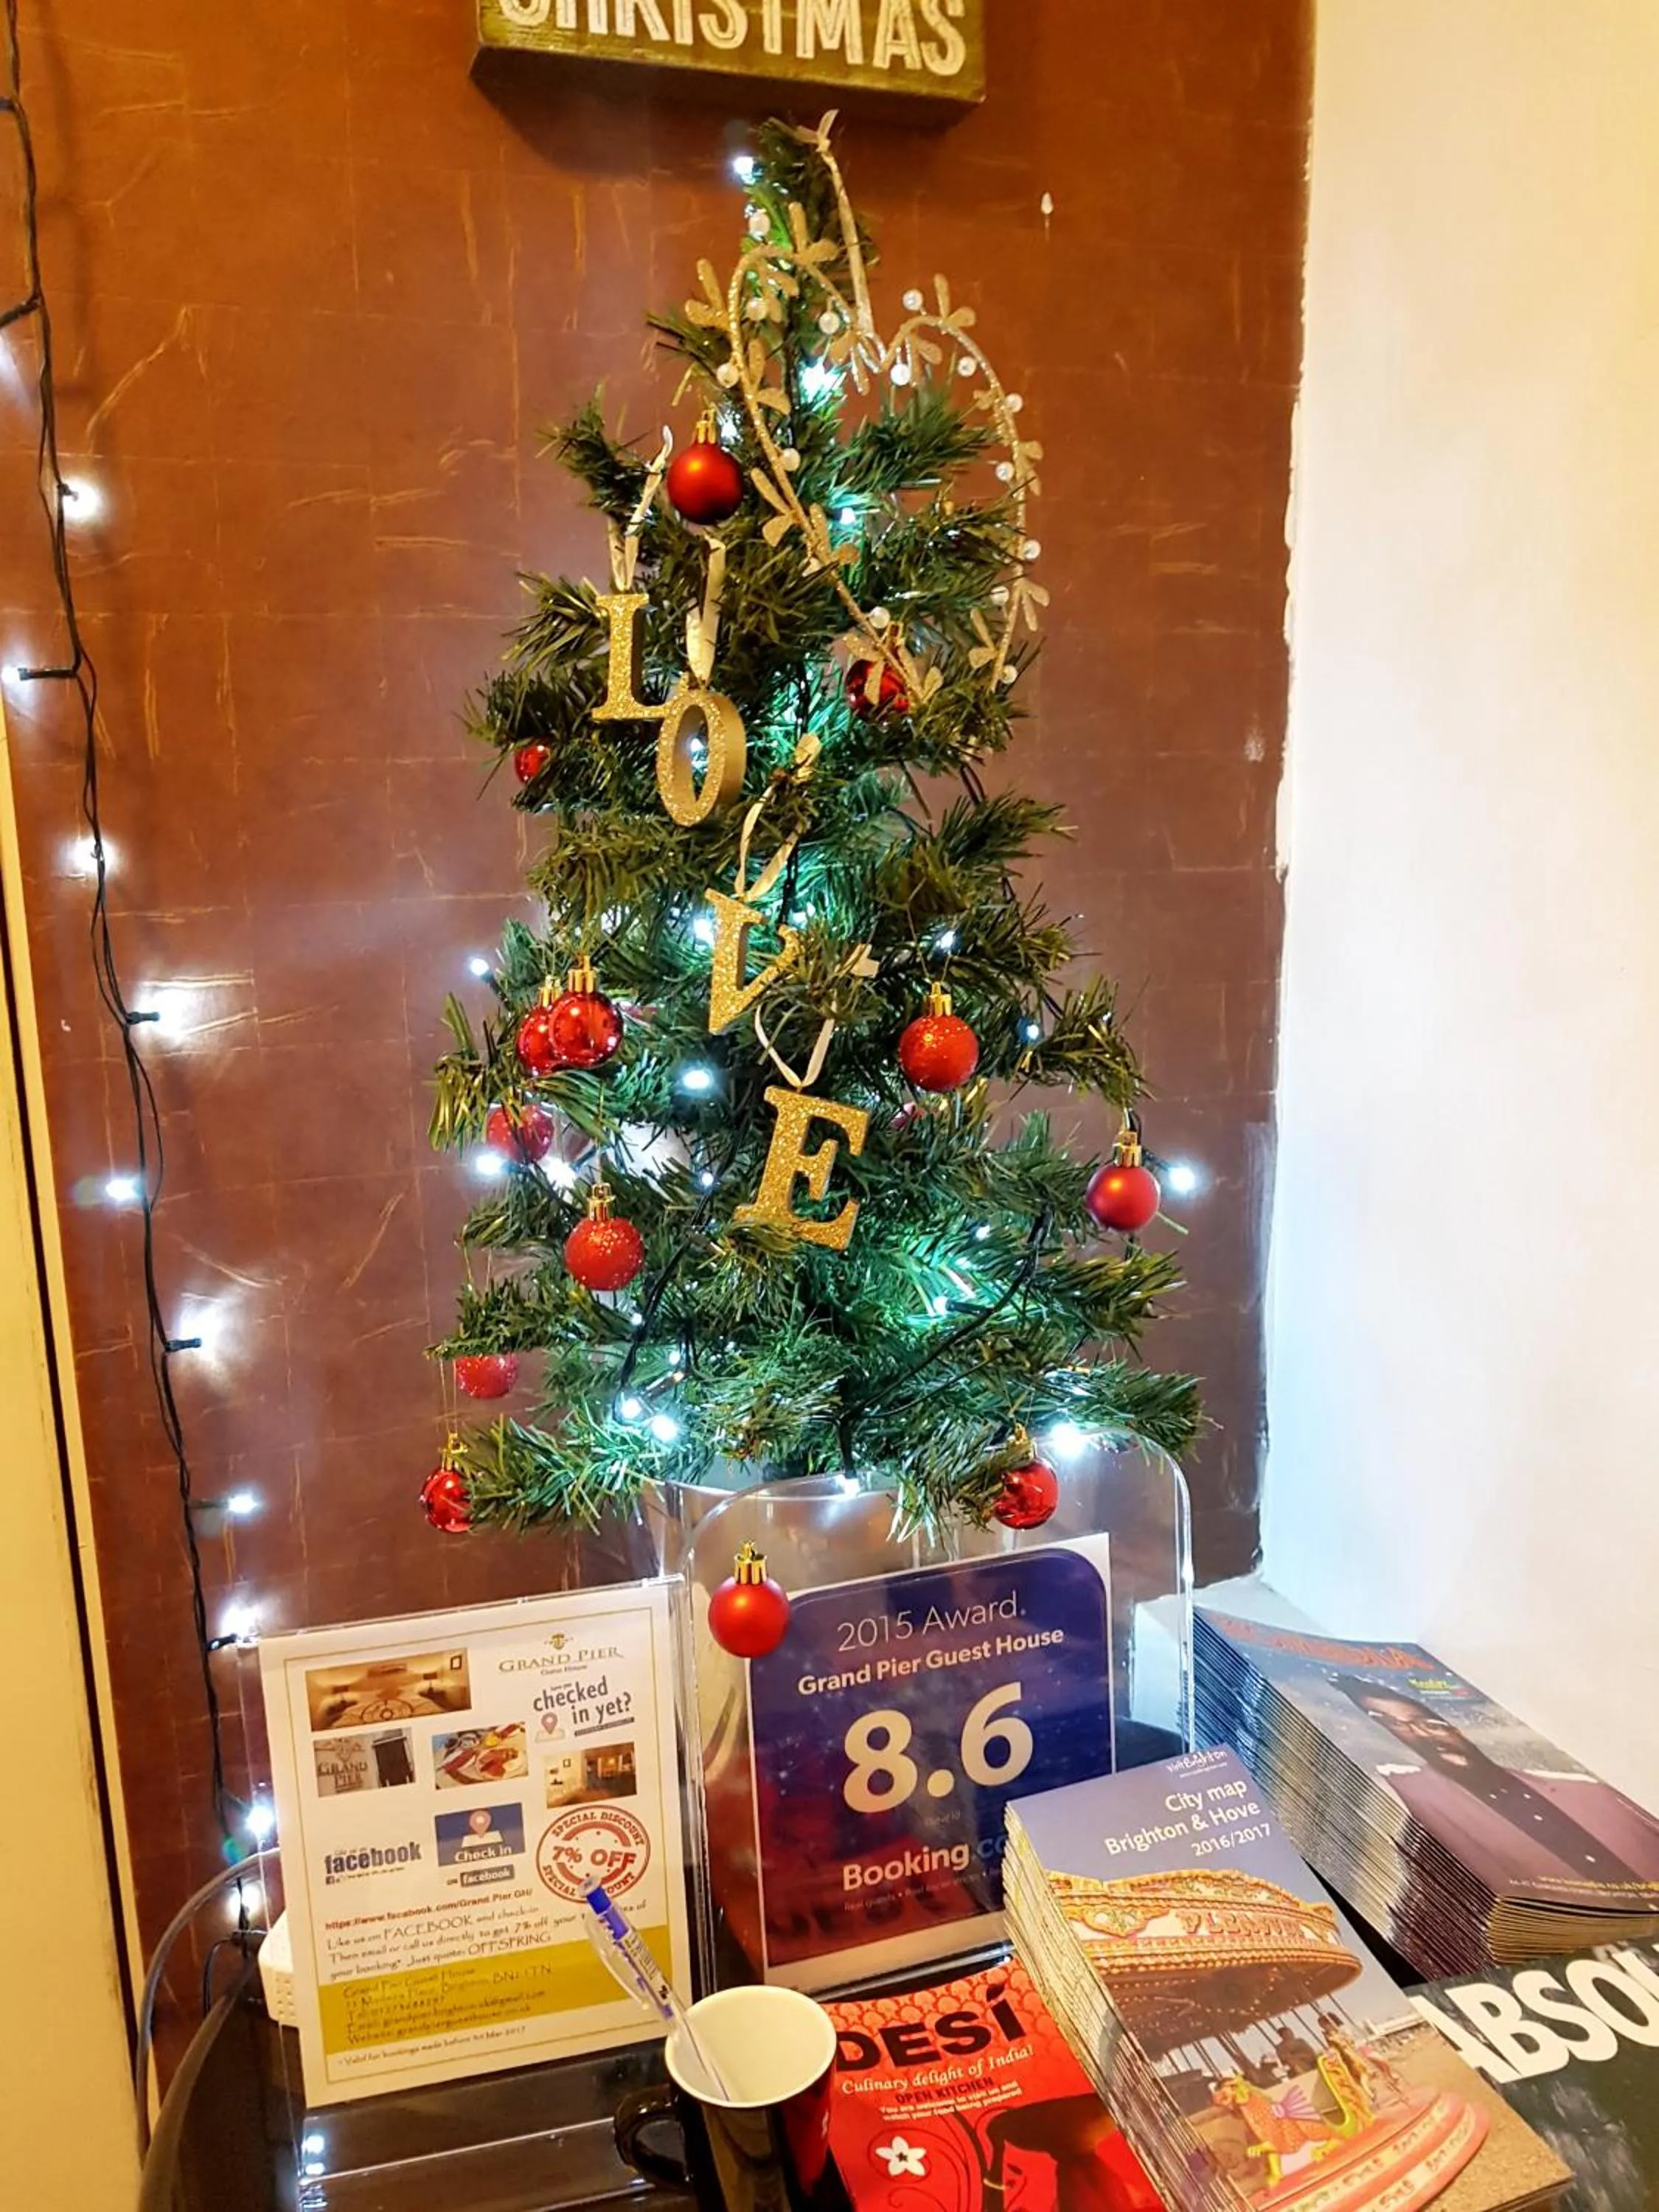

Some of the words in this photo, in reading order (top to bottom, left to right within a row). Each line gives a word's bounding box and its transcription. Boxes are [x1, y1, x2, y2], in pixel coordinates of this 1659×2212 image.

[500, 0, 966, 75] ISTMAS
[838, 1611, 914, 1652] 2015
[922, 1590, 1026, 1636] Award.
[498, 1655, 571, 1673] GRAND
[578, 1646, 624, 1660] PIER
[798, 1667, 872, 1696] Grand
[877, 1658, 922, 1680] Pier
[925, 1644, 992, 1671] Guest
[996, 1628, 1065, 1655] House
[532, 1674, 608, 1711] checked
[571, 1703, 590, 1725] in
[595, 1691, 632, 1725] yet?
[843, 1682, 1034, 1813] 8.6
[1166, 1792, 1203, 1811] City
[1207, 1781, 1248, 1801] map
[552, 1812, 597, 1837] SPECIAL
[600, 1812, 644, 1846] DISCOUNT
[1105, 1822, 1190, 1855] Brighton
[1192, 1815, 1209, 1832] &
[1210, 1802, 1262, 1826] Hove
[1191, 1823, 1271, 1857] 2016/2017
[324, 1841, 422, 1874] facebook
[455, 1848, 497, 1863] Check
[552, 1846, 582, 1863] 7%
[591, 1848, 637, 1868] OFF
[462, 1867, 512, 1884] facebook
[543, 1864, 577, 1897] SPECIAL
[607, 1871, 635, 1894] OUNT
[384, 1916, 473, 1938] FACEBOOK
[468, 1932, 552, 1956] OFFSPRING
[1408, 1943, 1659, 2084] ABSO
[842, 2078, 908, 2095] Culinary
[912, 2066, 965, 2088] delight
[968, 2058, 985, 2077] of
[895, 2091, 932, 2103] OPEN
[936, 2076, 994, 2098] KITCHEN
